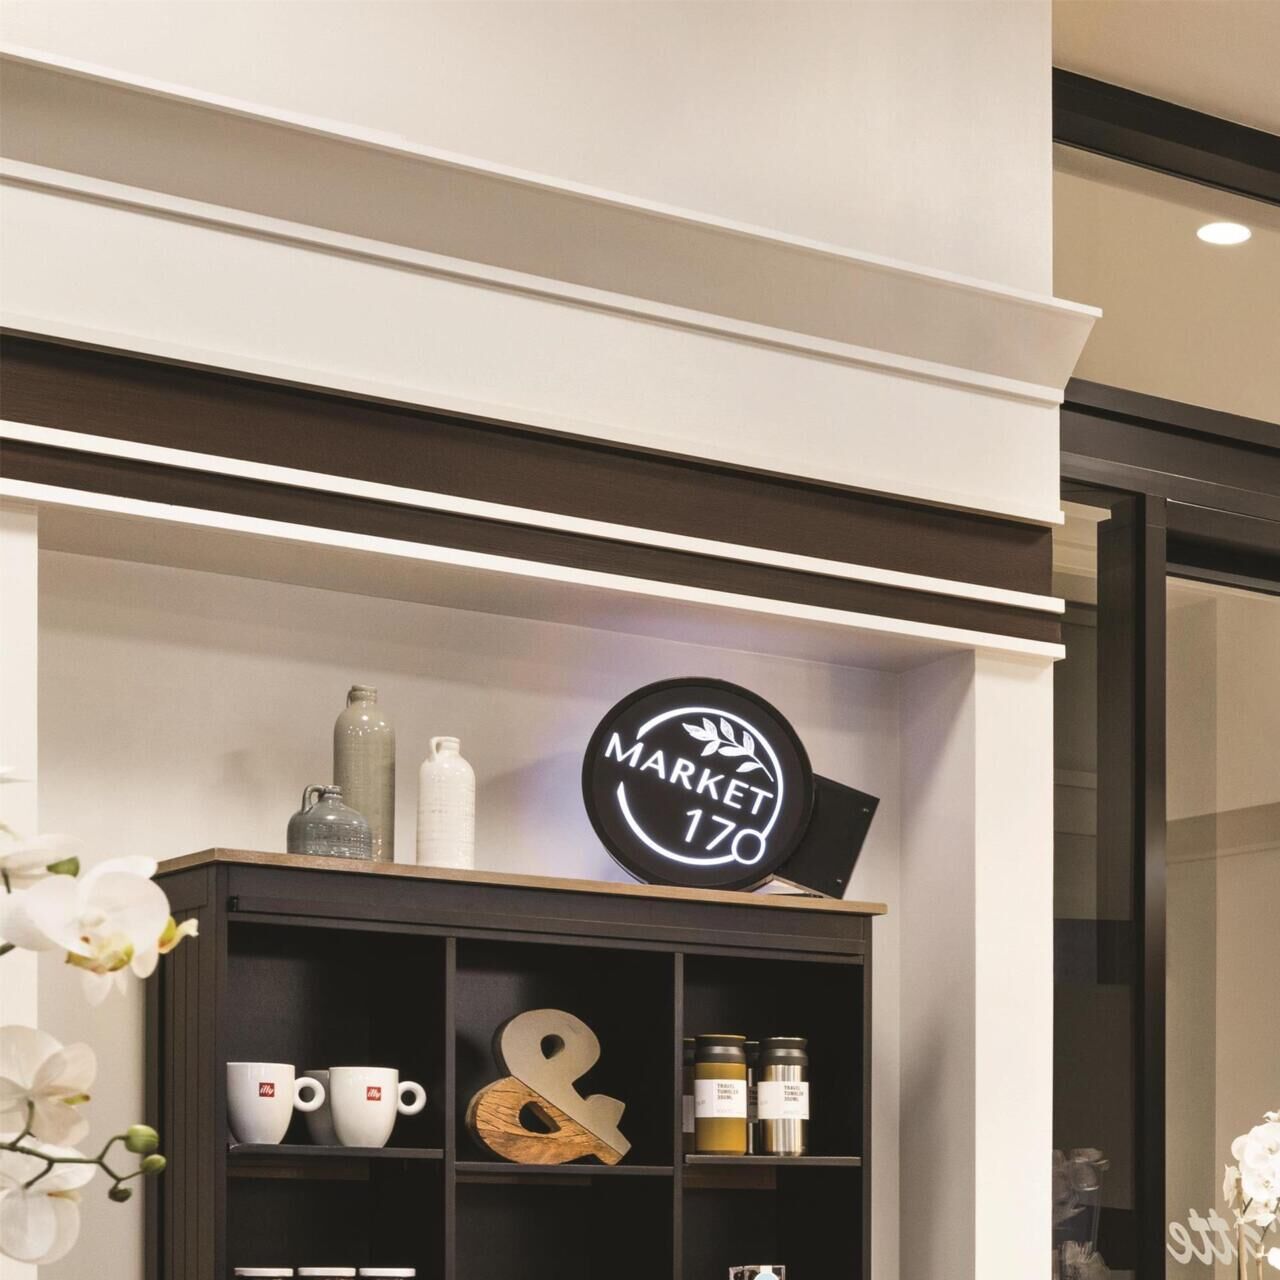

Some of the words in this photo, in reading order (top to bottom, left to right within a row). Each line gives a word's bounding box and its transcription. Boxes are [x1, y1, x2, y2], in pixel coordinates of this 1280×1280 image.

[604, 732, 774, 816] MARKET
[685, 808, 766, 866] 170
[259, 1084, 275, 1096] illy
[367, 1087, 382, 1099] illy
